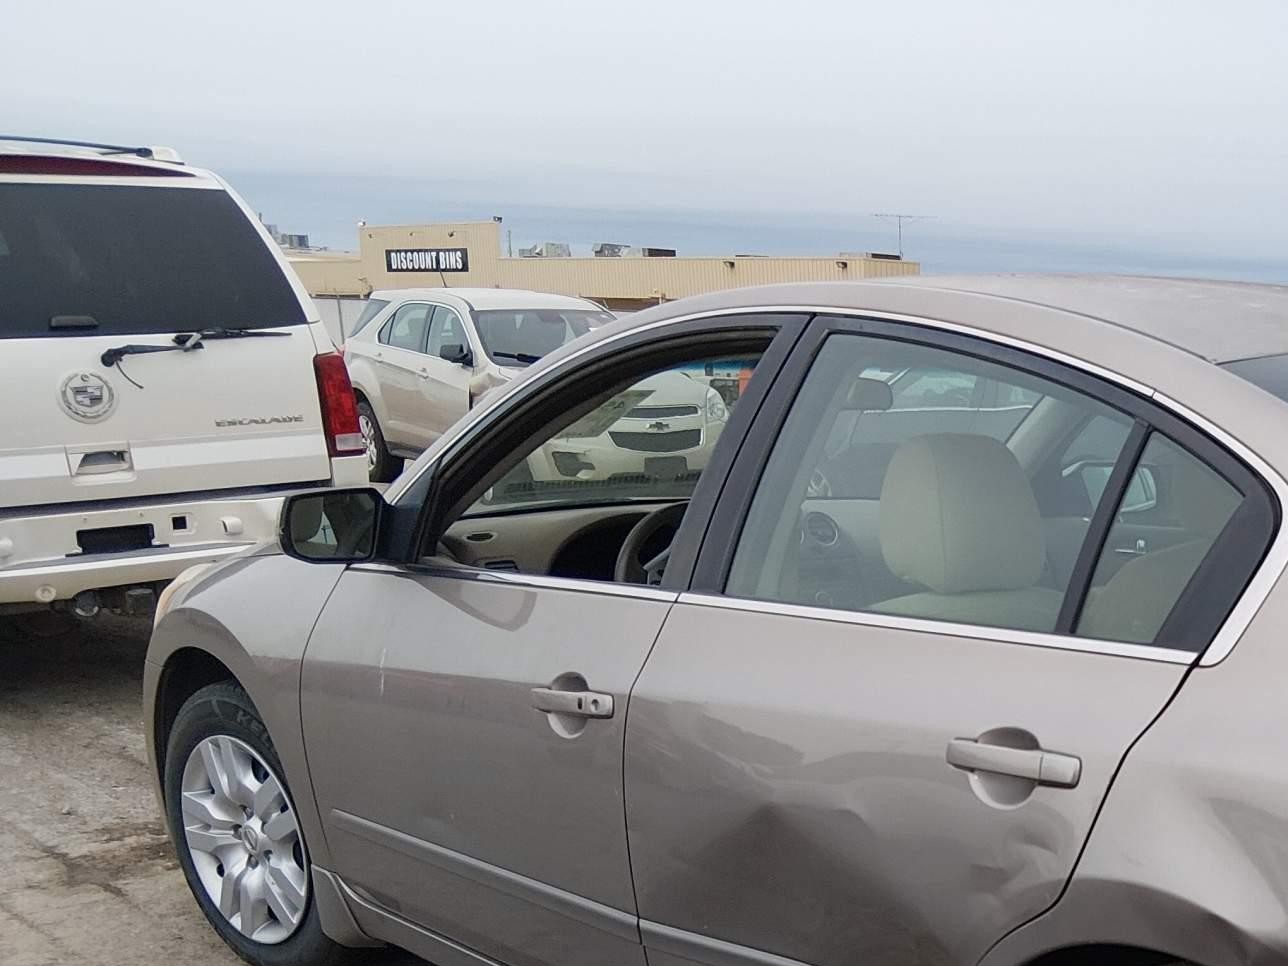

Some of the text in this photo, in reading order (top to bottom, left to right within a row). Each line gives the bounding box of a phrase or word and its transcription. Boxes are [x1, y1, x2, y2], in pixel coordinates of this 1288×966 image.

[391, 251, 463, 270] DISCOUNT BINS
[215, 414, 304, 427] ESCALADE
